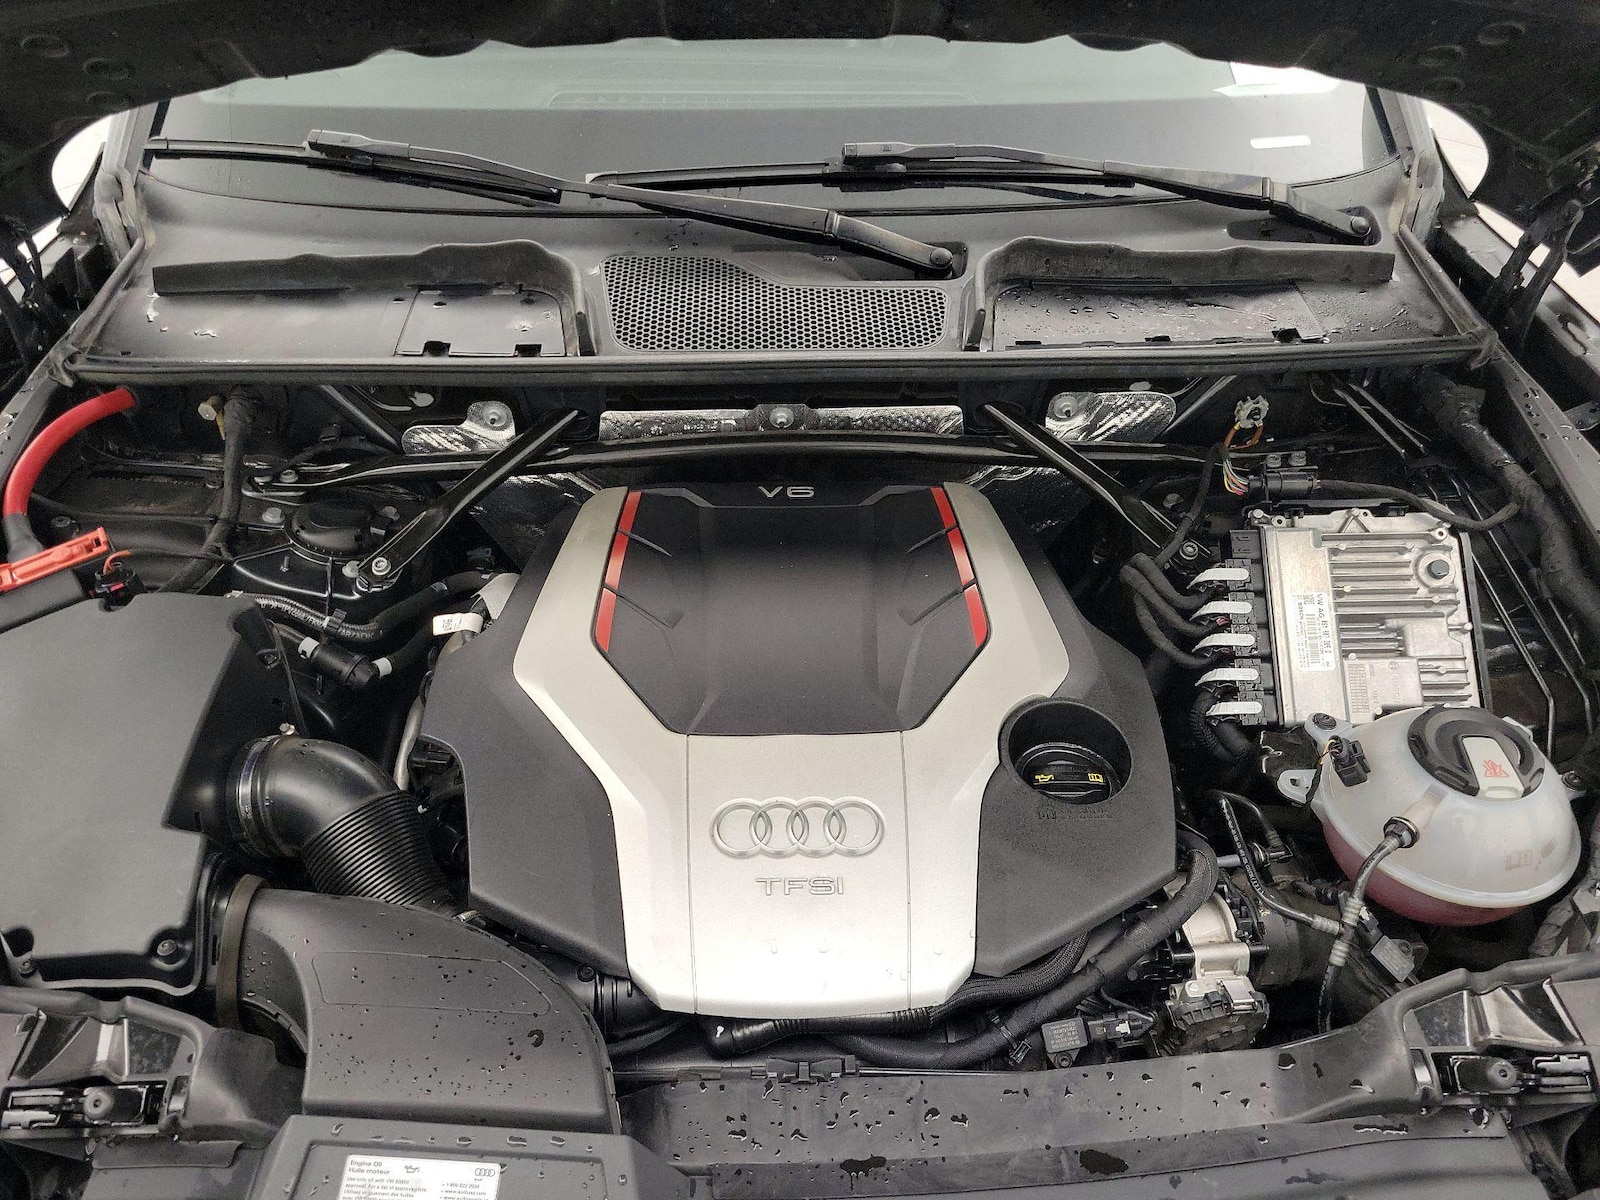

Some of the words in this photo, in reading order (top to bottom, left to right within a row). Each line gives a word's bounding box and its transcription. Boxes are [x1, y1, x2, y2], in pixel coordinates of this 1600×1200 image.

[758, 485, 815, 498] V6
[1318, 607, 1325, 619] AG
[756, 877, 844, 896] TFSI
[350, 1159, 372, 1167] Engine
